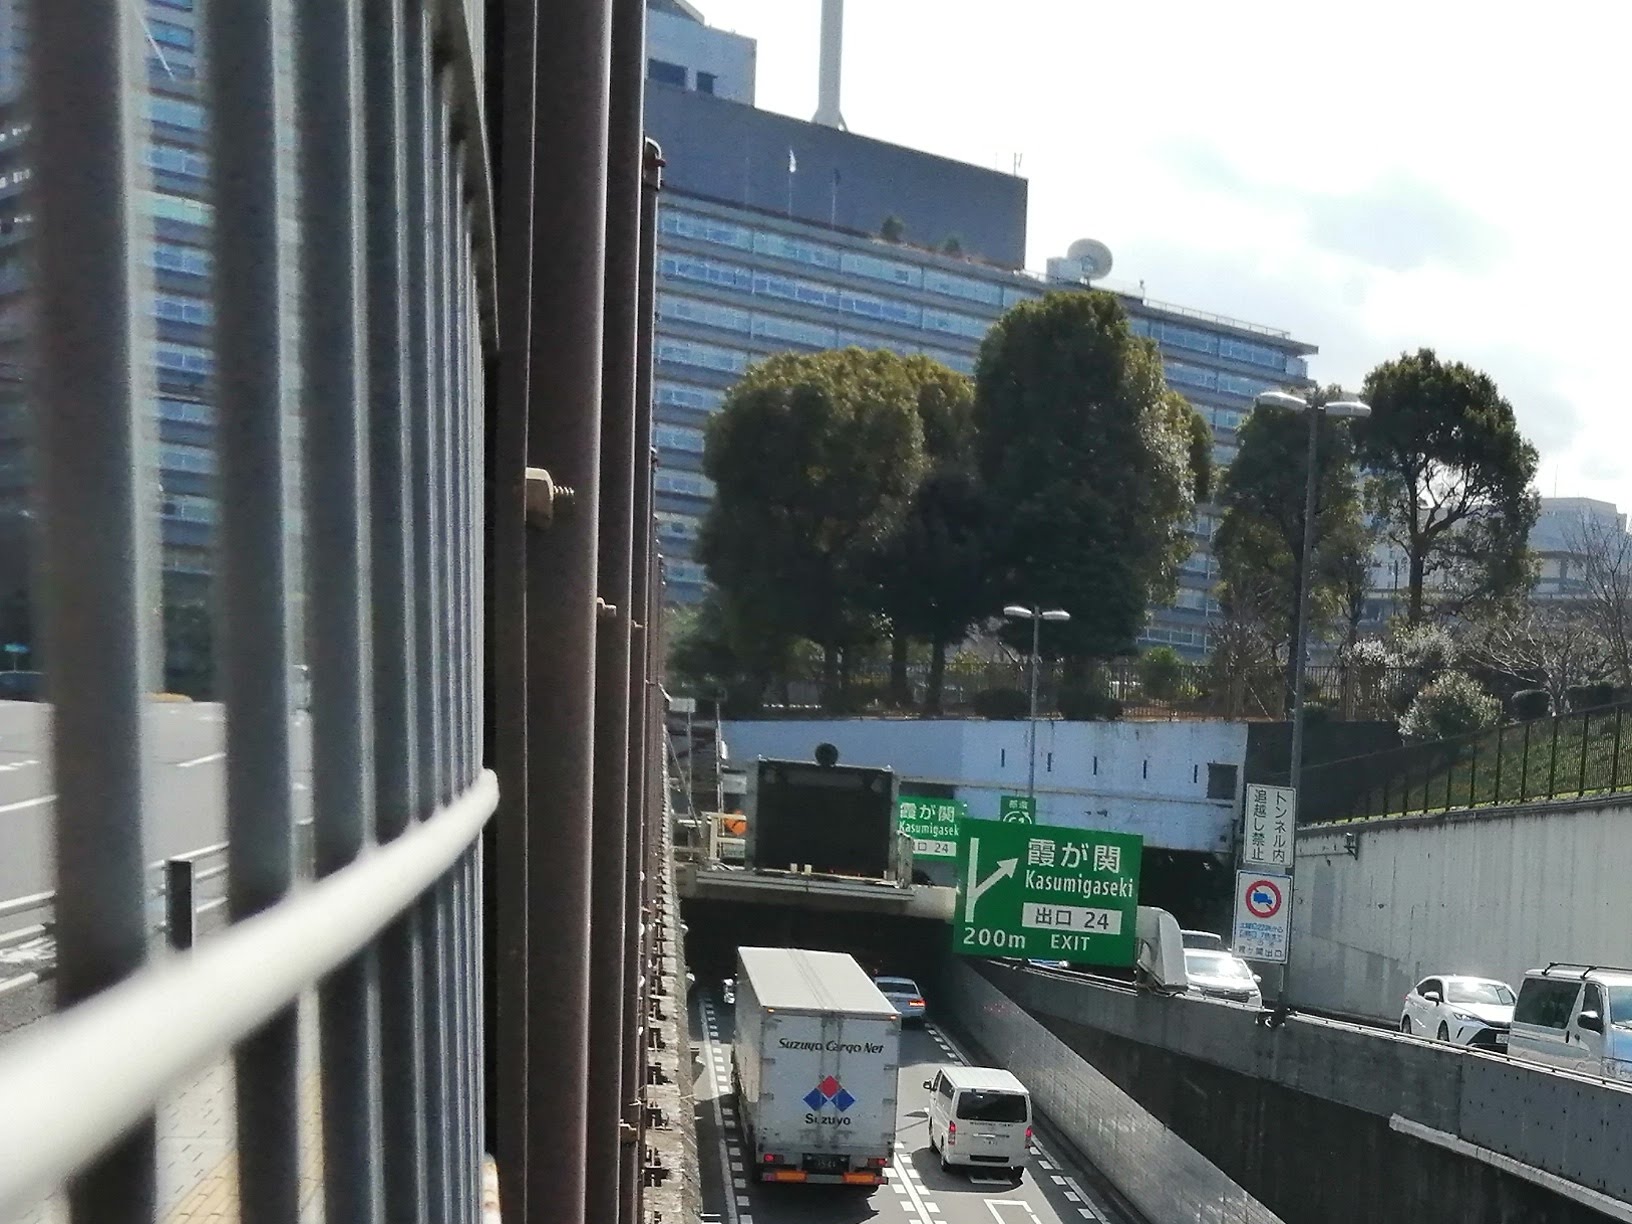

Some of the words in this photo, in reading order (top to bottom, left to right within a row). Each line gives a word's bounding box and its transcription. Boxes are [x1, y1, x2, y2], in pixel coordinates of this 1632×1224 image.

[899, 802, 955, 823] 霞が関
[898, 820, 960, 838] Kasumigasek
[1250, 788, 1267, 861] 追越し禁止
[1272, 790, 1288, 863] トンネル内
[934, 843, 949, 854] 24
[1027, 838, 1121, 874] 霞が関
[1025, 869, 1134, 899] Kasumigaseki
[1035, 907, 1072, 927] 出口
[1084, 911, 1109, 930] 24
[963, 927, 1026, 949] 200m
[1051, 934, 1091, 951] EXIT
[778, 1037, 824, 1052] Suzuyo
[825, 1040, 862, 1054] Cargo
[863, 1042, 885, 1054] Net
